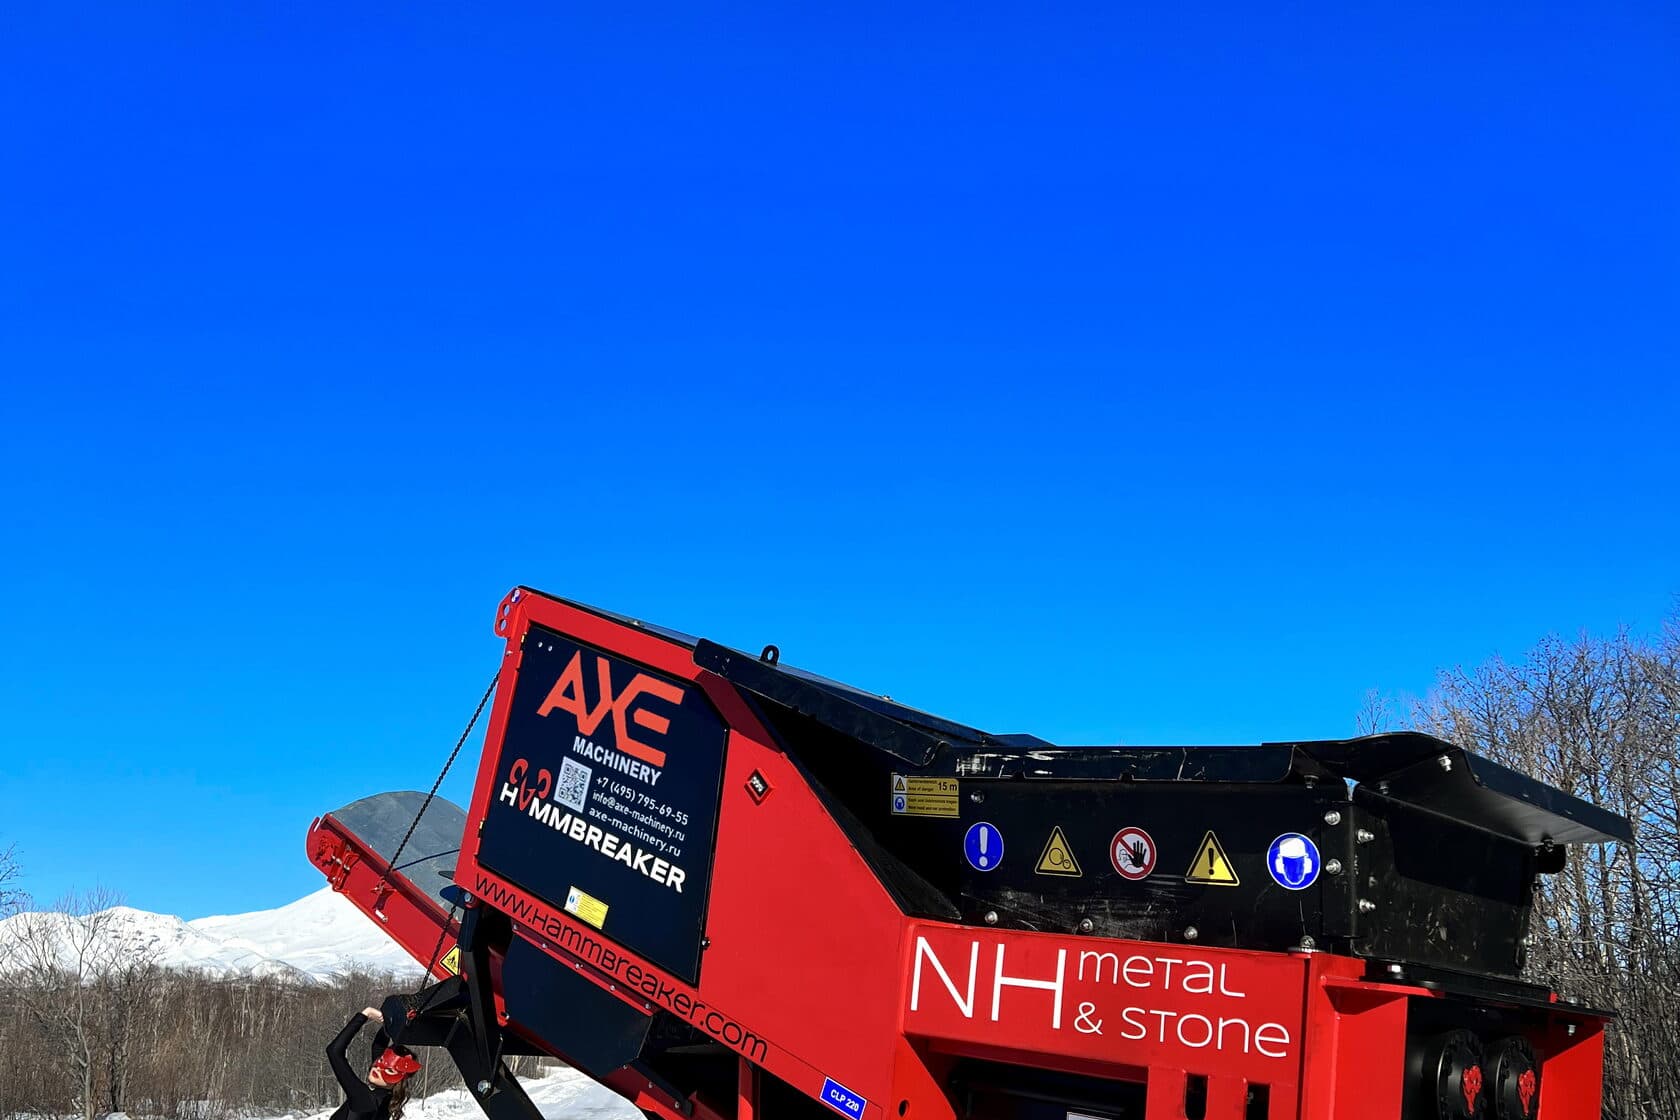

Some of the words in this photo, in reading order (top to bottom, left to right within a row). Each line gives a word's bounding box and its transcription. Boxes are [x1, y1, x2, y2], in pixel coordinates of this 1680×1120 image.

[536, 650, 685, 768] AXE
[573, 736, 662, 786] MACHINERY
[938, 781, 948, 791] 15
[592, 790, 685, 842] info@axe-machinery.ru
[596, 777, 609, 788] +7
[610, 781, 636, 802] (495)
[637, 793, 689, 826] 795-69-55
[588, 807, 681, 857] axe-machinery.ru
[910, 936, 1066, 1030] NH
[1073, 1001, 1104, 1036] &
[830, 1089, 846, 1103] CLP
[845, 1098, 860, 1112] 220
